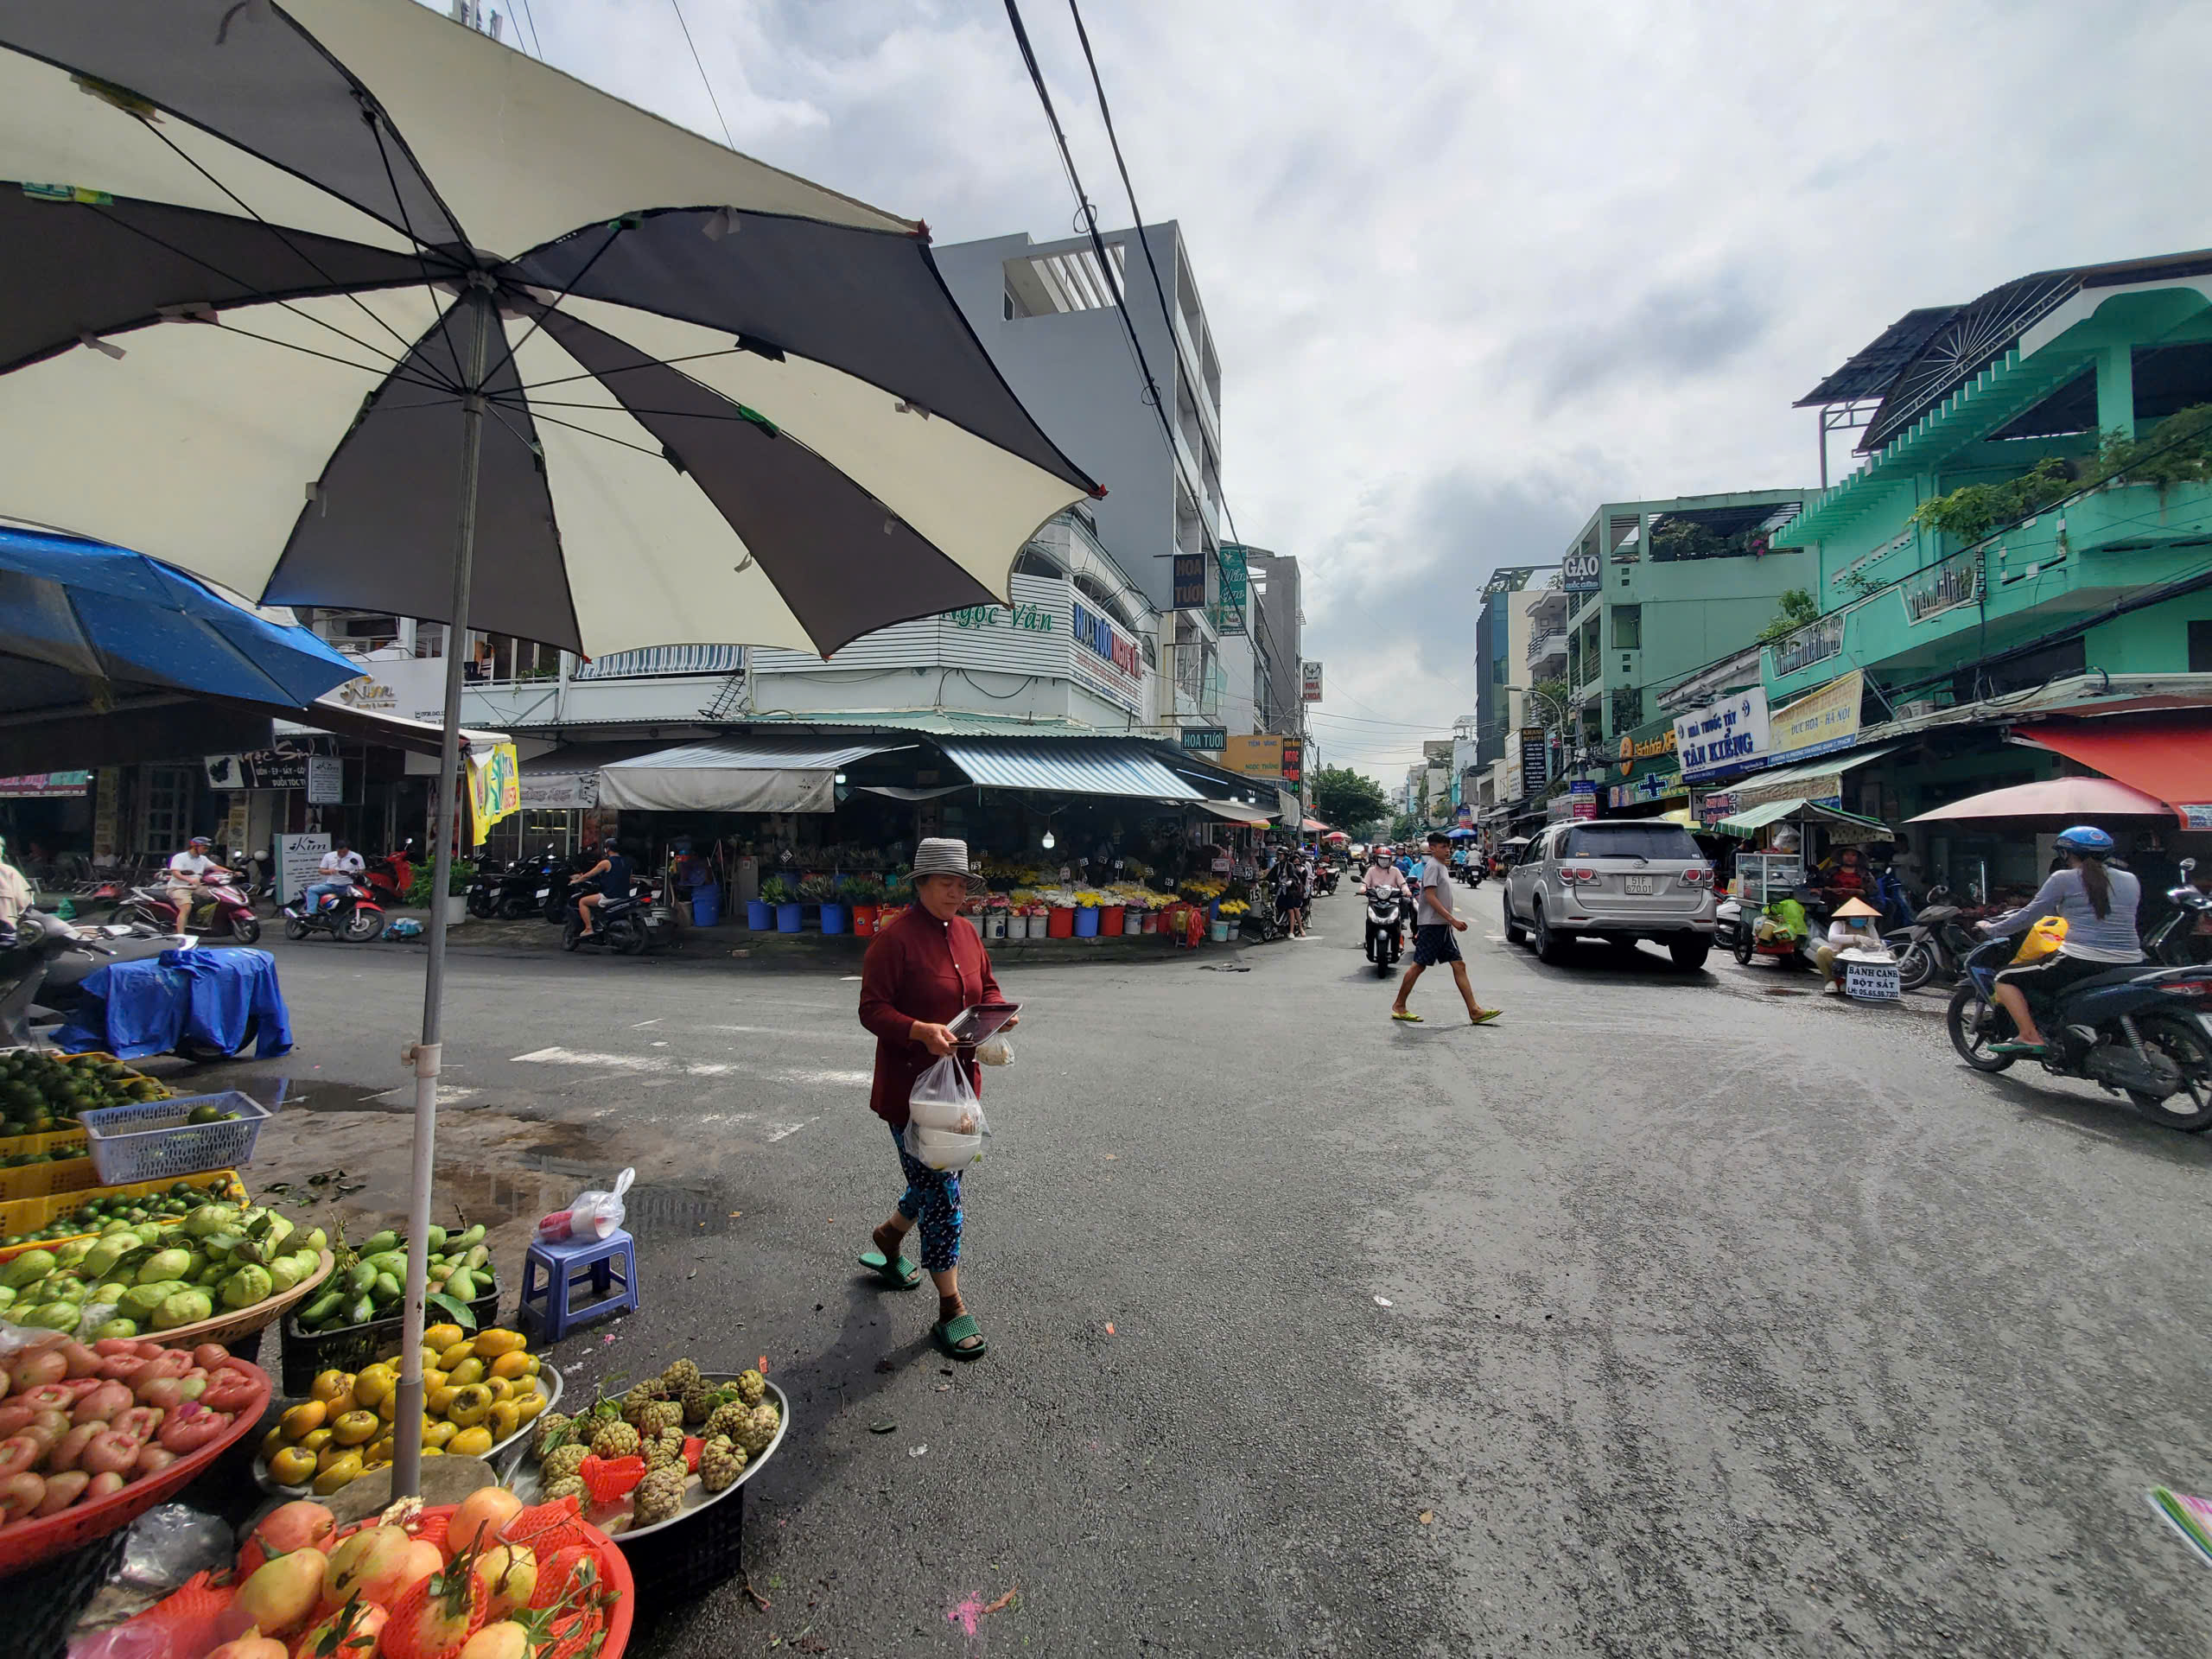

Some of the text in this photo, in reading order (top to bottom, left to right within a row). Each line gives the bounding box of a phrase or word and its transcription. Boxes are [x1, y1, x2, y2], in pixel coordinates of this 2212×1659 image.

[1176, 559, 1202, 576] HOA
[1564, 556, 1599, 581] GẠO
[1176, 584, 1204, 602] TƯƠI
[1011, 605, 1053, 631] Vân
[1073, 601, 1095, 648] HOA
[1184, 732, 1224, 748] HOA TƯƠI
[1682, 728, 1753, 767] TÂN KIỂNG
[294, 836, 326, 851] Kim
[1631, 876, 1646, 885] 51F
[1849, 965, 1898, 978] BÁNH CANH
[1853, 978, 1873, 988] BỘT
